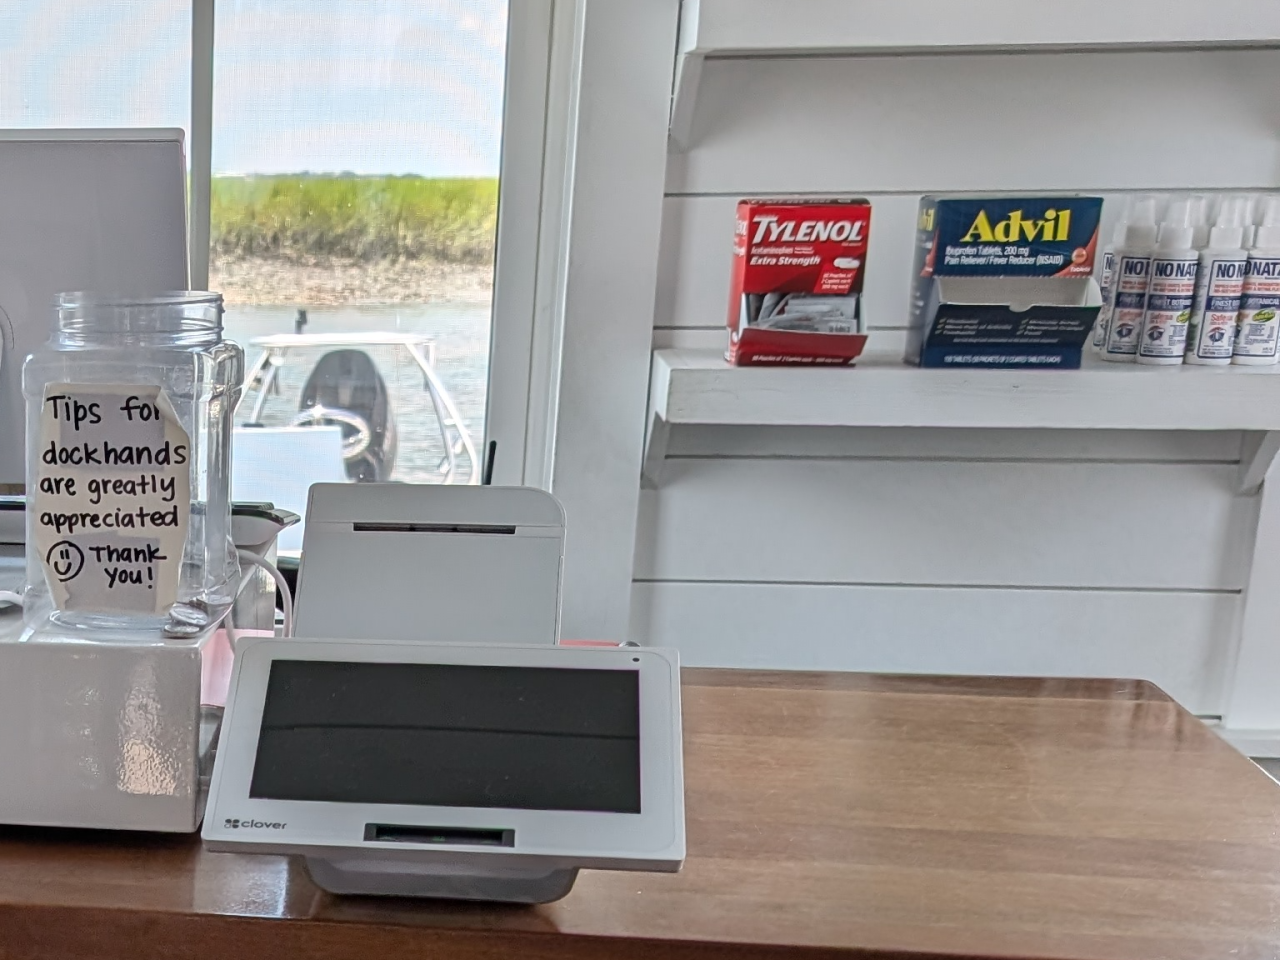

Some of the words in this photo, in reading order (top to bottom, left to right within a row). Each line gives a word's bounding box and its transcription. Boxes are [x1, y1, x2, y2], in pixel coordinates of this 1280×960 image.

[751, 214, 863, 244] TYLENOL
[960, 208, 1071, 243] Advil
[945, 245, 977, 256] Ibuprofen
[1004, 246, 1017, 255] 200
[1018, 248, 1029, 257] mg
[750, 256, 778, 266] Extra
[779, 256, 821, 267] Strength
[944, 256, 960, 266] Pain
[1009, 256, 1035, 266] Reducer
[1037, 255, 1064, 267] (NSAID)
[1124, 260, 1144, 275] NO
[1155, 262, 1174, 277] NO
[1216, 263, 1235, 278] NO
[46, 395, 101, 431] Tips
[42, 441, 187, 466] dockhands
[40, 477, 76, 495] are
[88, 475, 176, 504] greatly
[40, 505, 179, 533] appreciated
[89, 544, 167, 563] Thank
[104, 567, 153, 589] you!
[240, 819, 287, 831] clover
